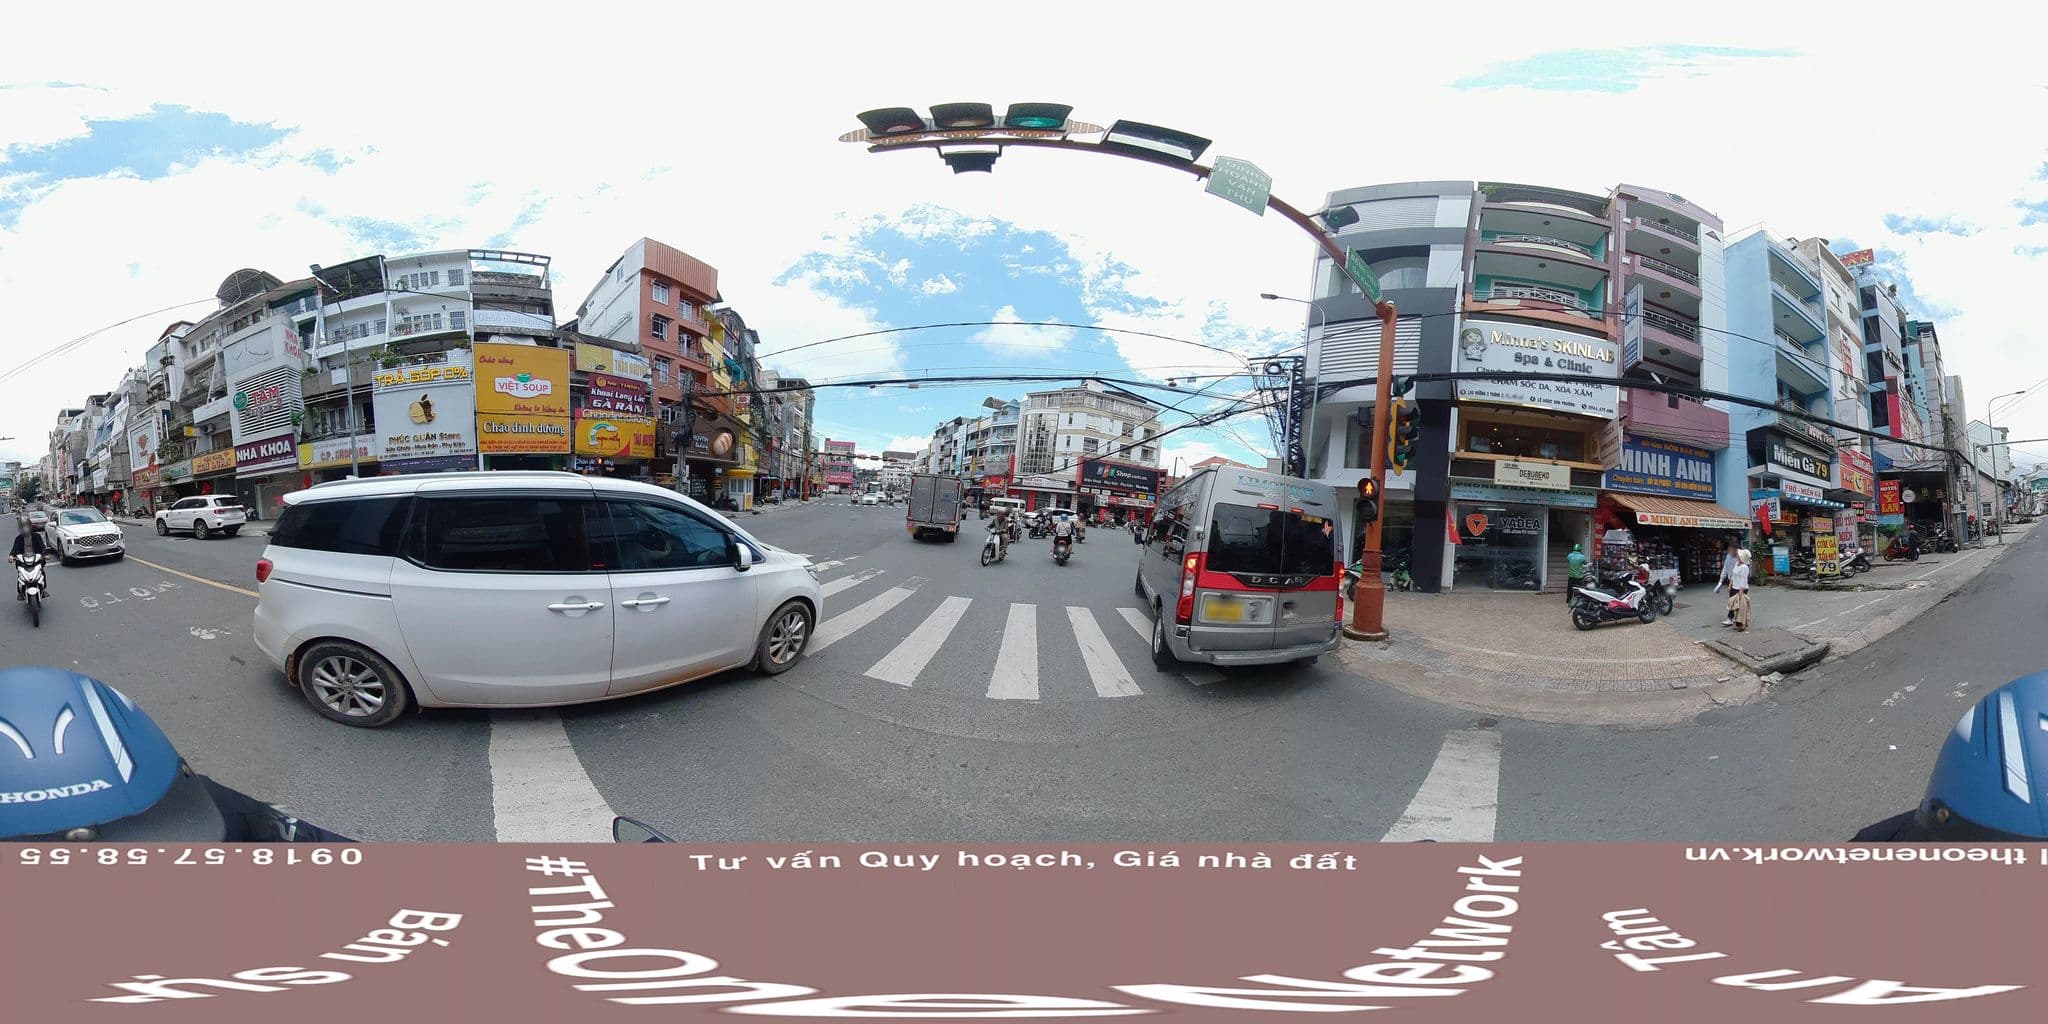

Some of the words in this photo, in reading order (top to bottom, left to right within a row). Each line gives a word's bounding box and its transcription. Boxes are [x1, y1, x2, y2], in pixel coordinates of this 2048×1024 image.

[1553, 338, 1615, 364] SKINLAB
[1514, 352, 1539, 367] Spa
[1544, 357, 1554, 367] &
[1557, 358, 1593, 375] Clinic
[375, 369, 406, 387] TRẢ
[409, 365, 441, 384] GÓP
[444, 366, 469, 380] 0%
[498, 381, 520, 393] VIỆT
[522, 383, 549, 393] SOUP
[483, 421, 511, 433] Cháo
[511, 421, 535, 433] dinh
[537, 424, 566, 436] dưỡng
[237, 447, 257, 462] NHA
[260, 440, 292, 457] KHOA
[1615, 449, 1671, 478] MINH
[1676, 458, 1712, 483] ANH
[1802, 457, 1815, 475] Gà
[1815, 462, 1828, 478] 79
[1500, 517, 1541, 530] YADEA
[1651, 515, 1676, 525] MINH
[1680, 517, 1699, 526] ANH
[1819, 563, 1837, 572] 79
[1, 778, 112, 805] HONDA
